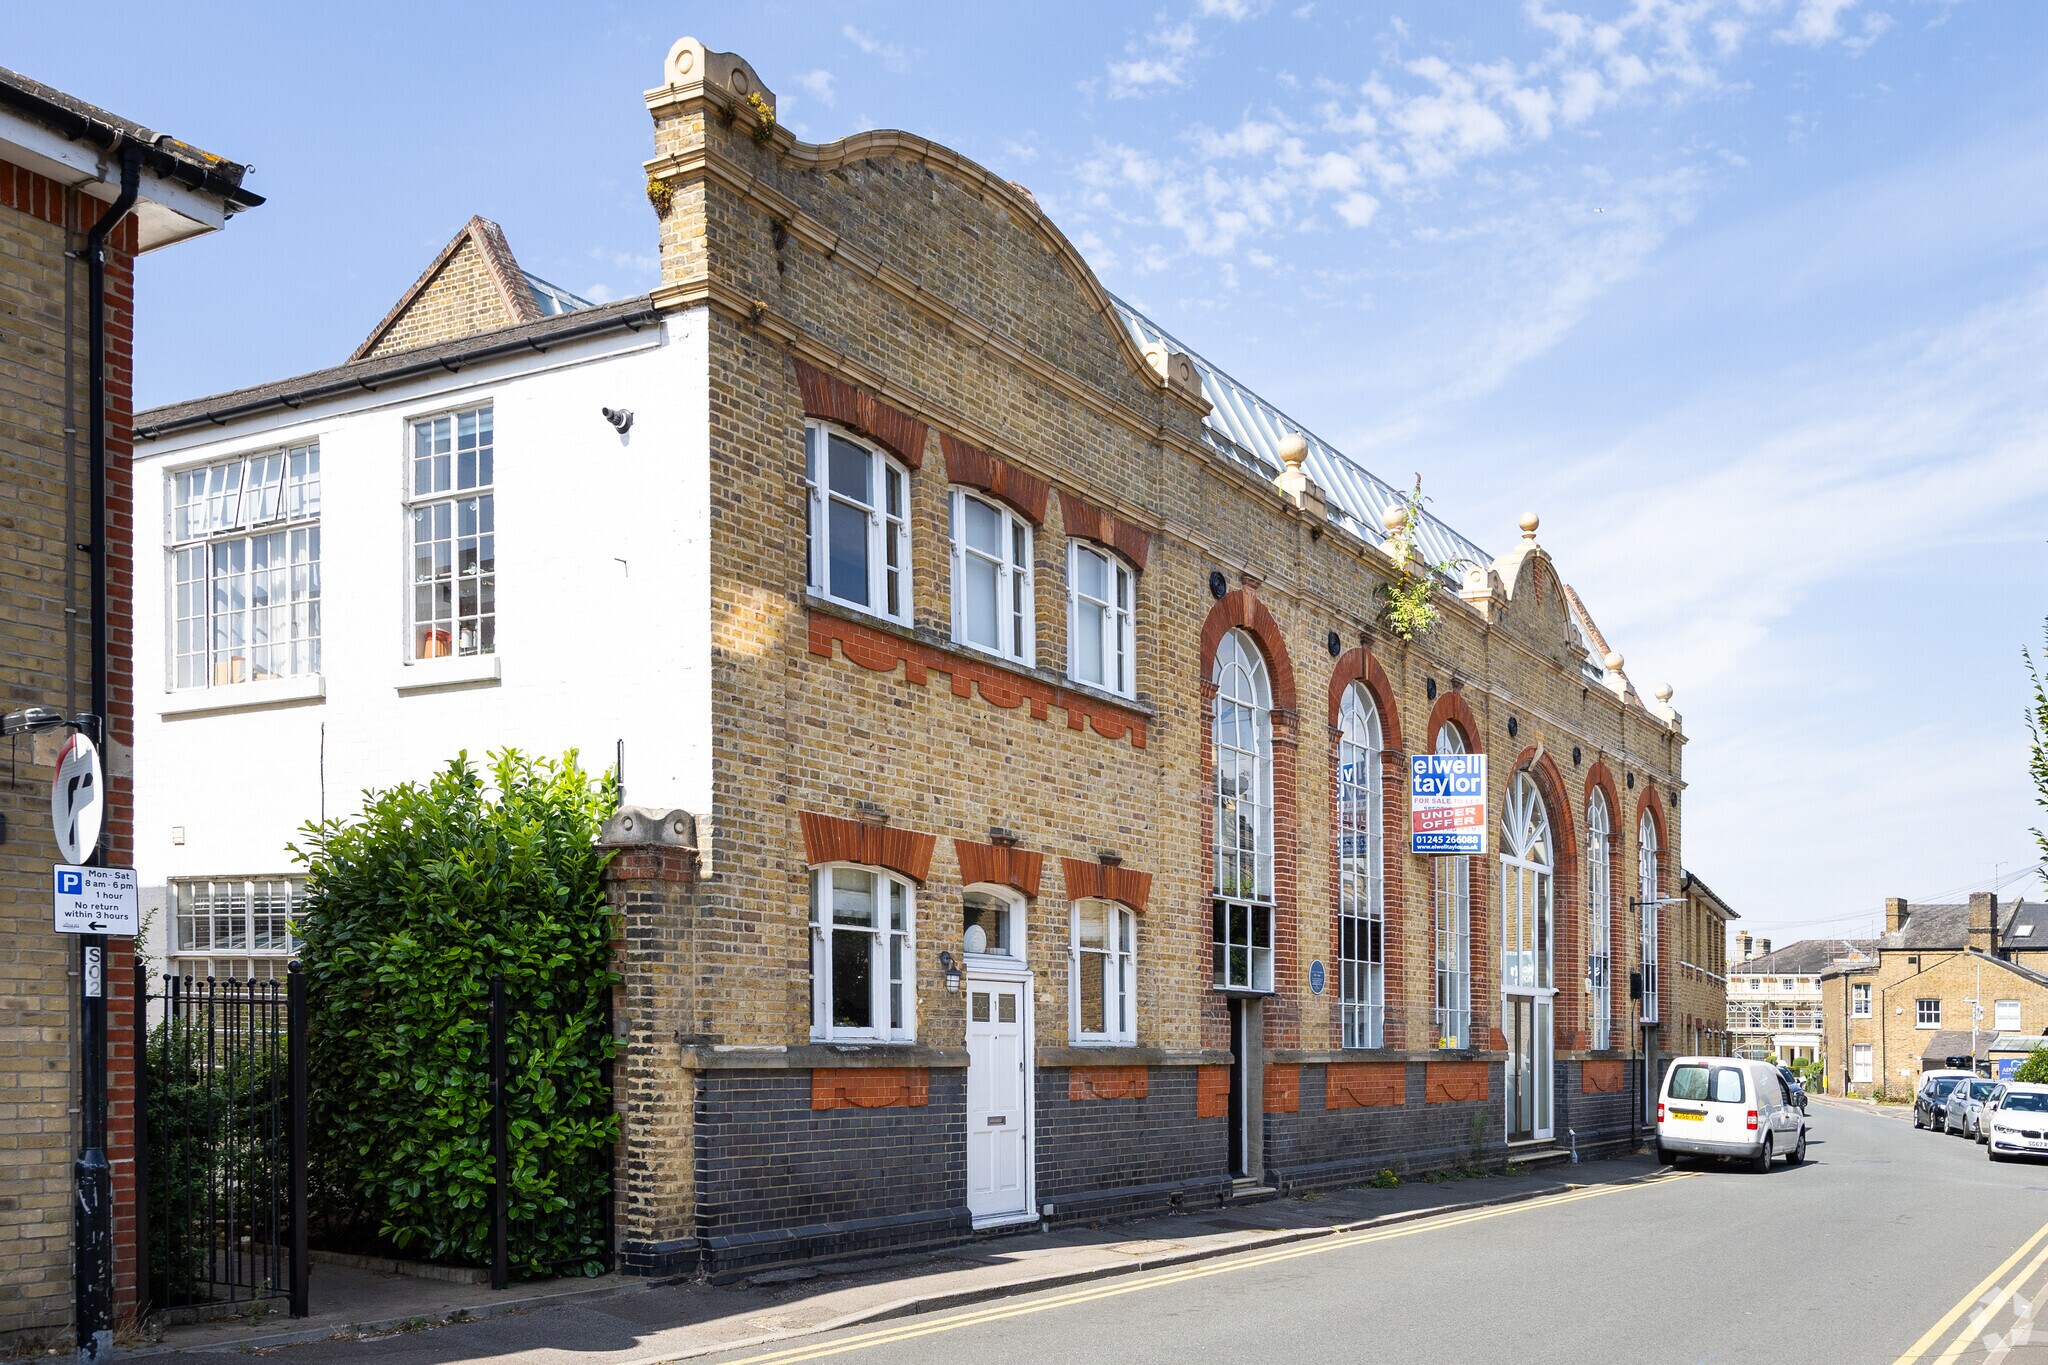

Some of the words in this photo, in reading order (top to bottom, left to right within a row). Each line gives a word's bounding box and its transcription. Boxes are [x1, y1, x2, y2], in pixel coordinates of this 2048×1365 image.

[1414, 755, 1479, 774] elwell
[1414, 773, 1480, 796] taylor
[1421, 807, 1476, 819] UNDER
[1422, 816, 1475, 829] OFFER
[1416, 836, 1443, 844] 01245
[1445, 836, 1479, 844] 266088
[88, 870, 107, 878] Mon
[114, 871, 130, 879] Sat
[63, 873, 79, 892] P
[75, 901, 88, 909] No
[64, 910, 93, 918] within
[104, 912, 129, 920] hours
